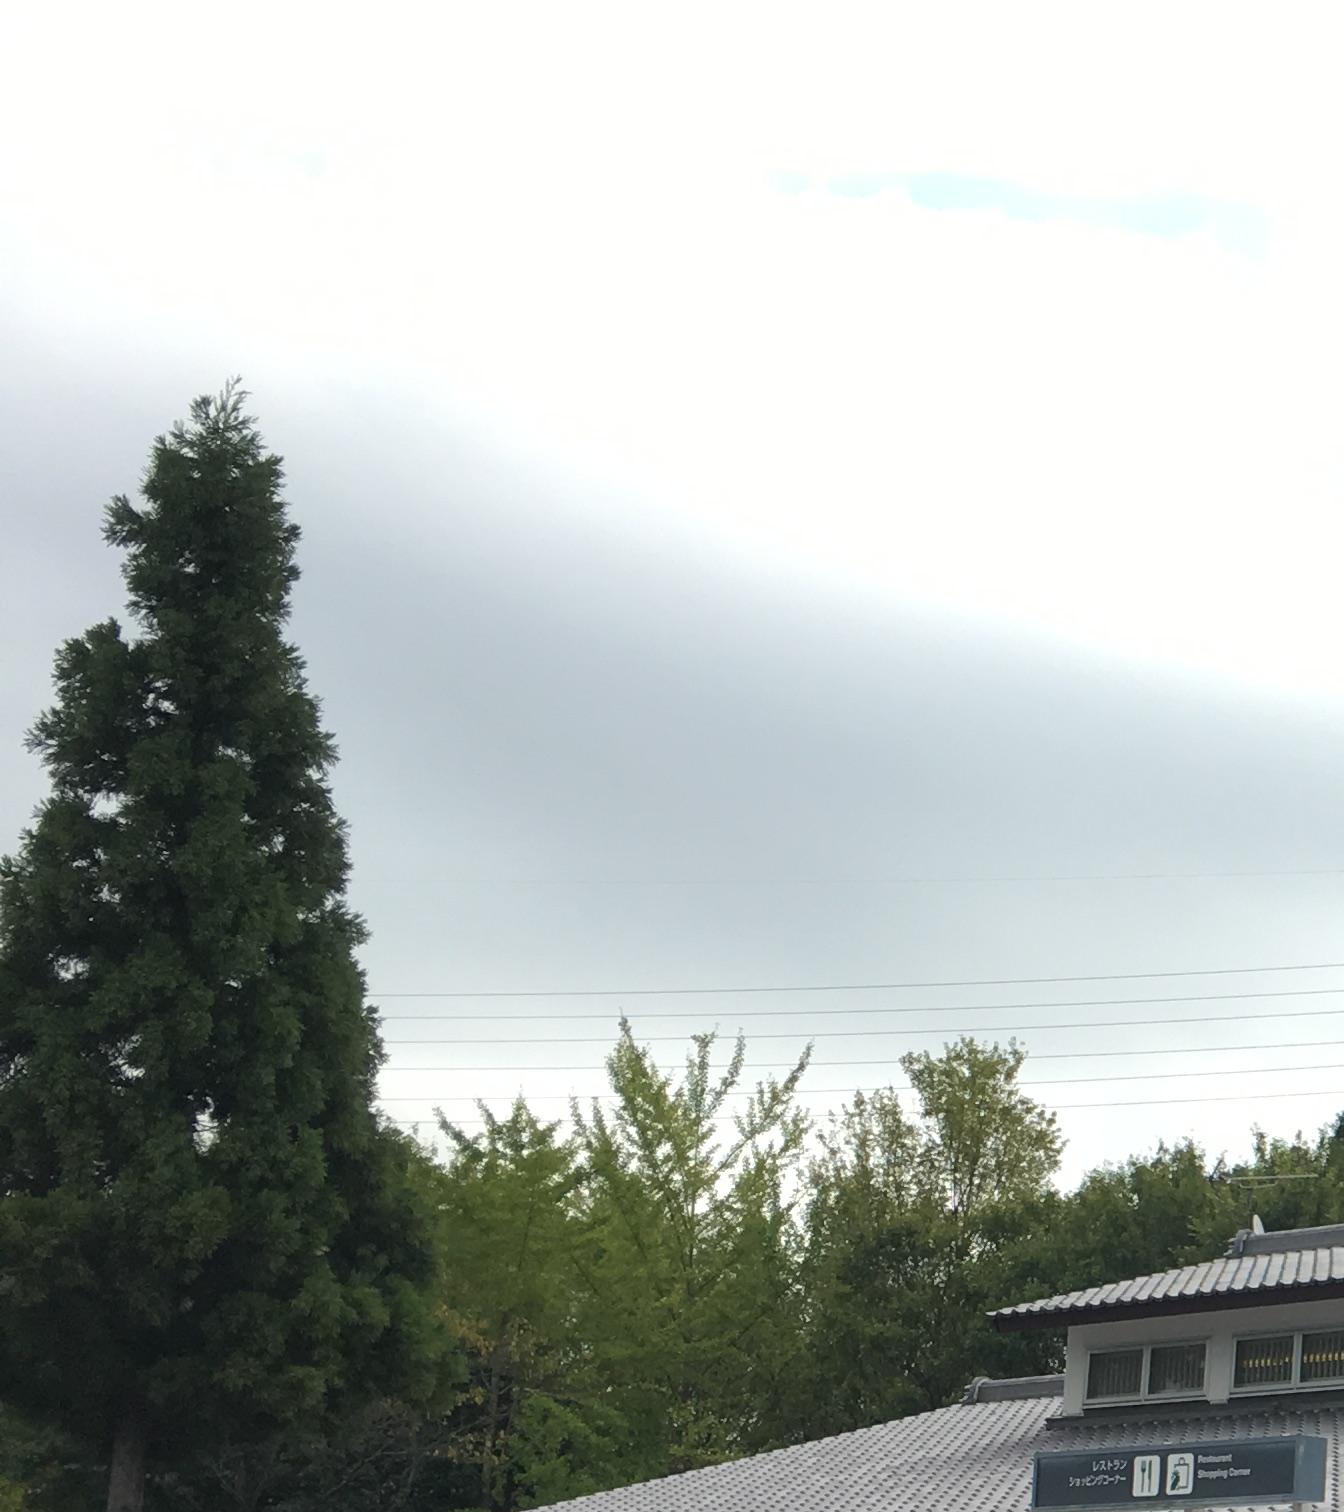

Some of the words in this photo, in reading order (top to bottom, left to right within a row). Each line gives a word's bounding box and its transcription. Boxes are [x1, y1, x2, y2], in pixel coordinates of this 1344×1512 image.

[1092, 1459, 1128, 1472] レストラン
[1069, 1474, 1127, 1487] ショッピングコーナー
